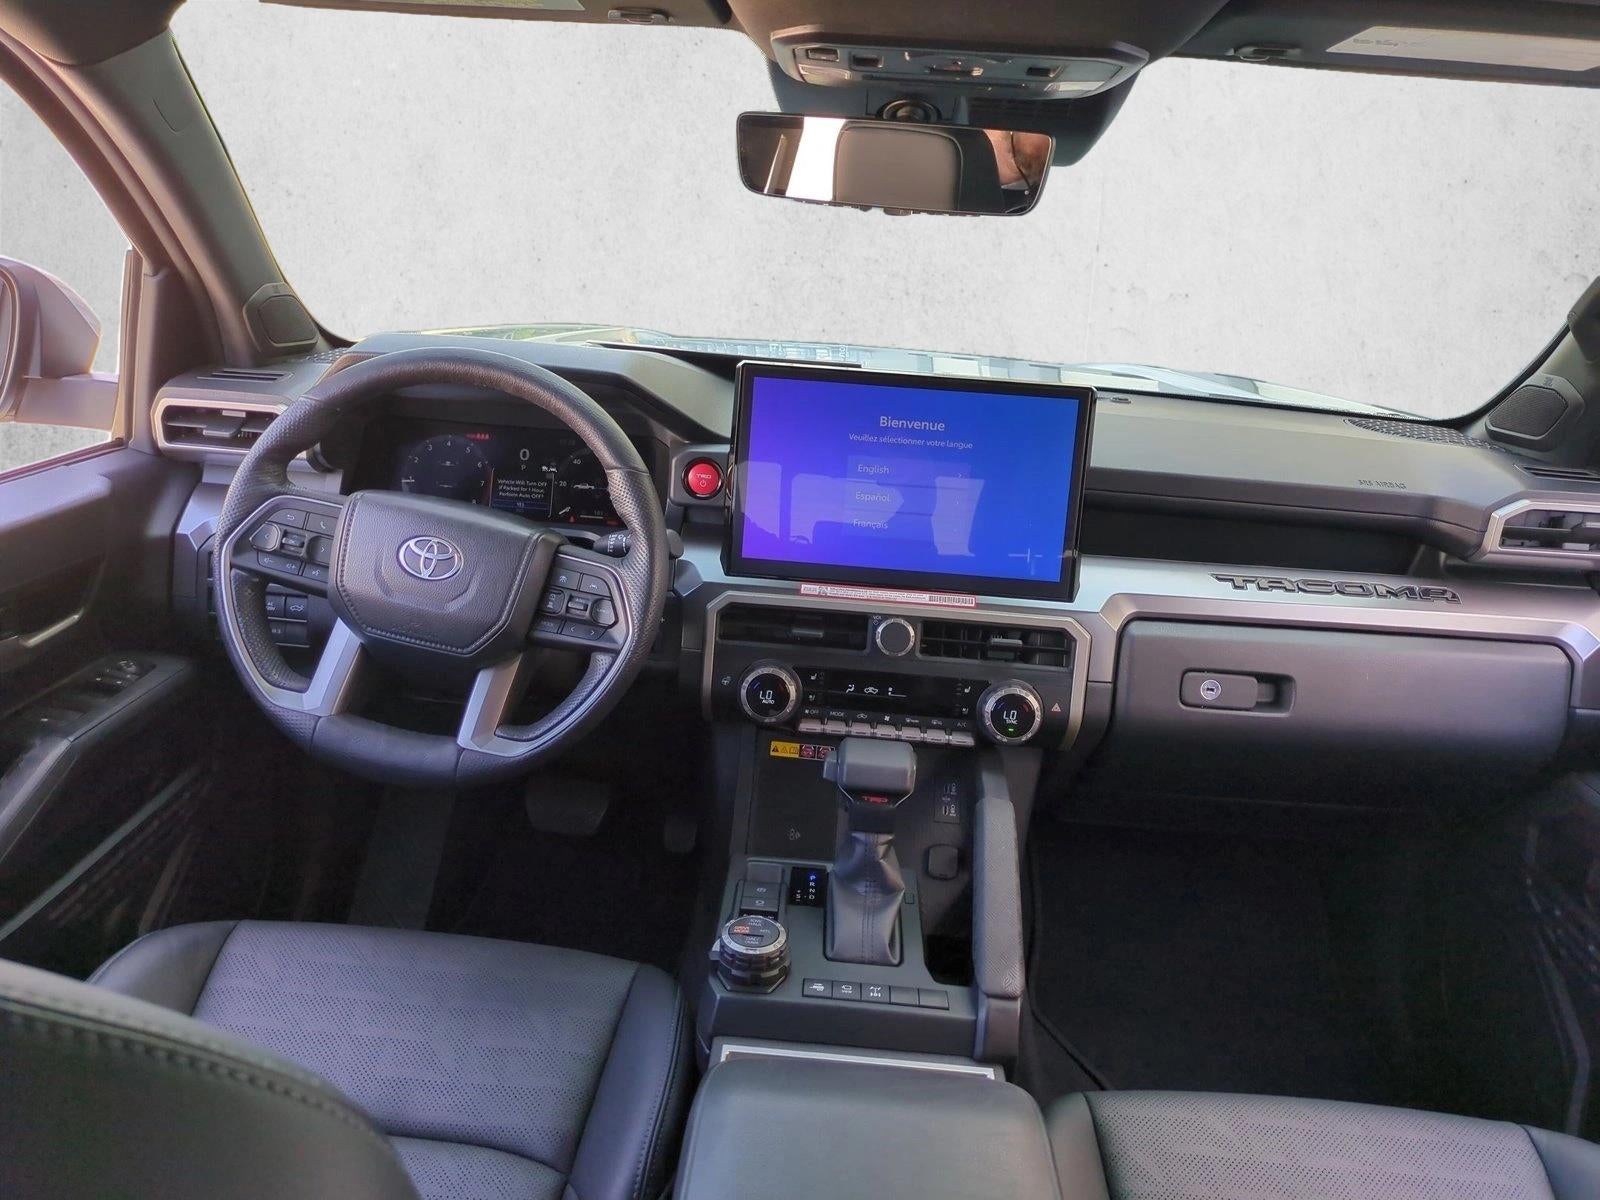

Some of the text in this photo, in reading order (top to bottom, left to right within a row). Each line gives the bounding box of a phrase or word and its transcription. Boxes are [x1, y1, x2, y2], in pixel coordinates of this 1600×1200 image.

[880, 415, 945, 431] Bienvenue
[849, 433, 973, 450] Veuillez sélectionner votre langue
[520, 448, 529, 461] 0
[857, 463, 890, 475] English
[855, 490, 891, 503] Español
[853, 518, 888, 530] Français
[1208, 573, 1463, 605] TACOMA
